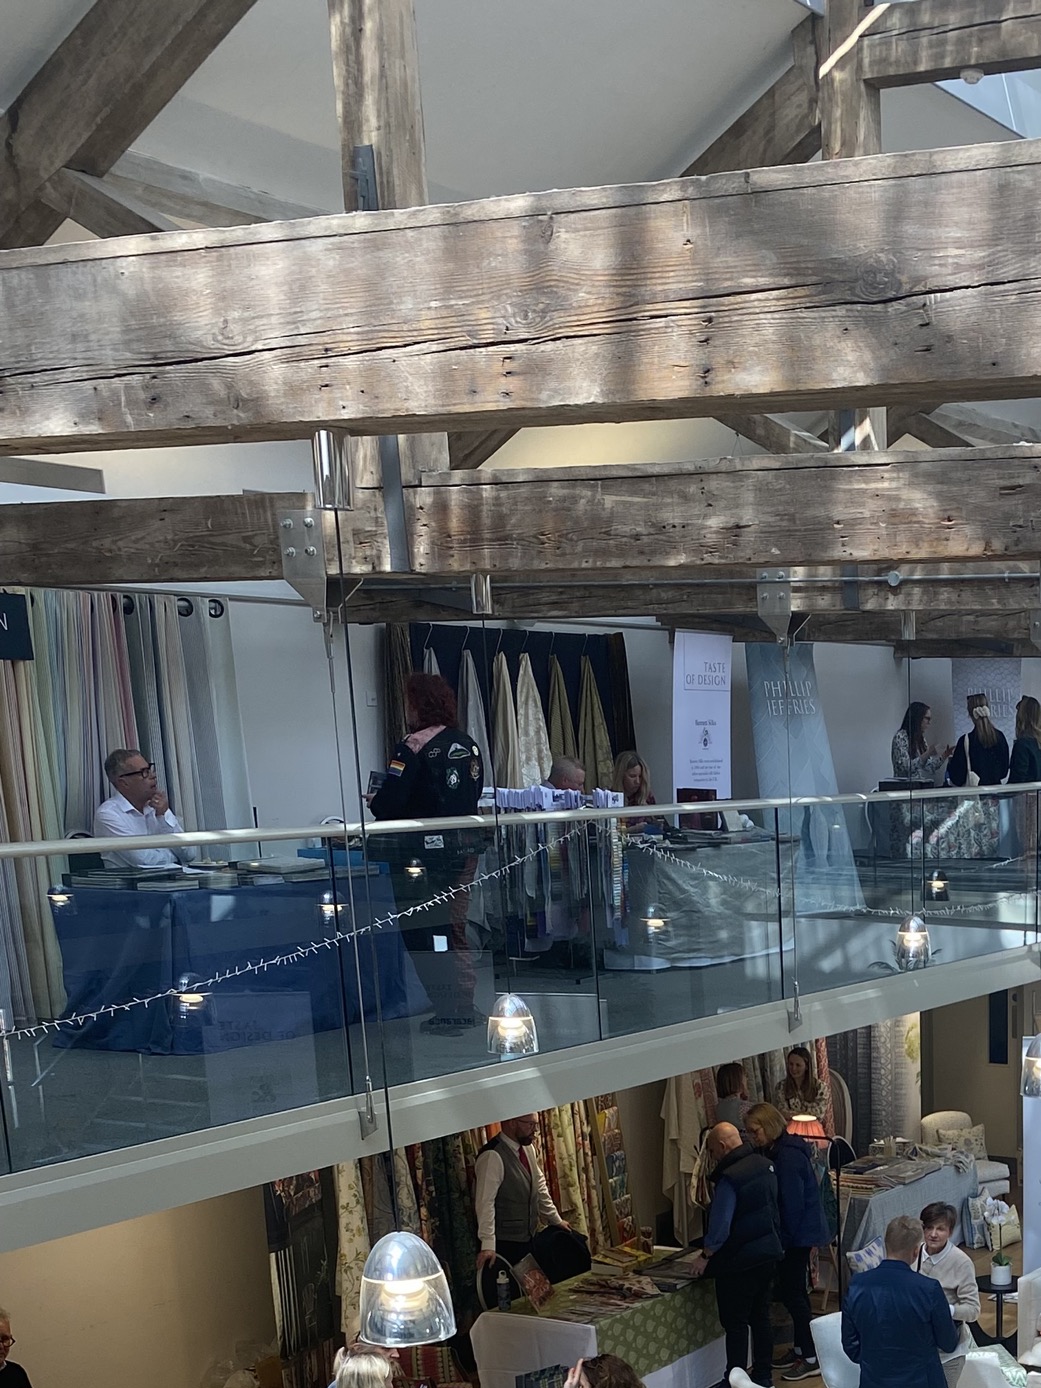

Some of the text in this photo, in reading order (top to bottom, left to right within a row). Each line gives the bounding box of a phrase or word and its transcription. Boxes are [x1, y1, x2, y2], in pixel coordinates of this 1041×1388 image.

[704, 661, 726, 673] TASTE
[685, 673, 726, 686] OF DESIGN
[766, 699, 816, 717] JEFFRIES
